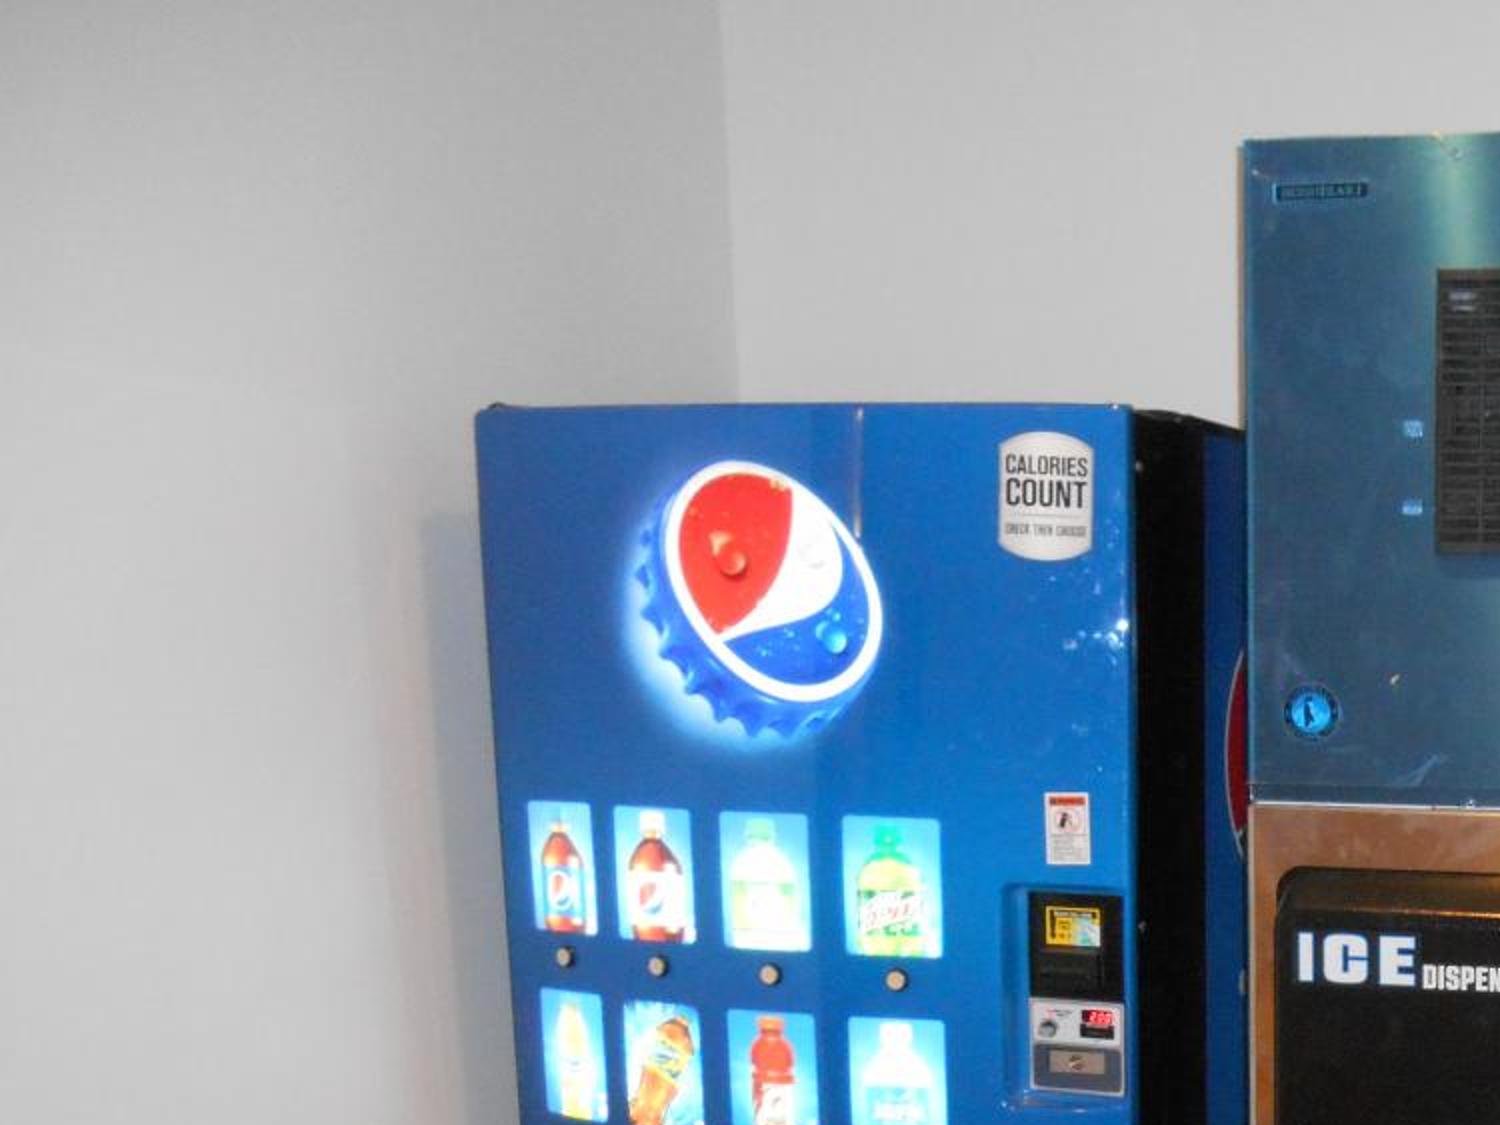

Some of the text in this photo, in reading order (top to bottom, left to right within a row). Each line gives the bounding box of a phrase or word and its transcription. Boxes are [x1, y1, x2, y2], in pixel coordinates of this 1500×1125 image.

[1005, 453, 1088, 477] CALORIES
[1006, 477, 1088, 509] COUNT
[1298, 931, 1416, 987] ICE
